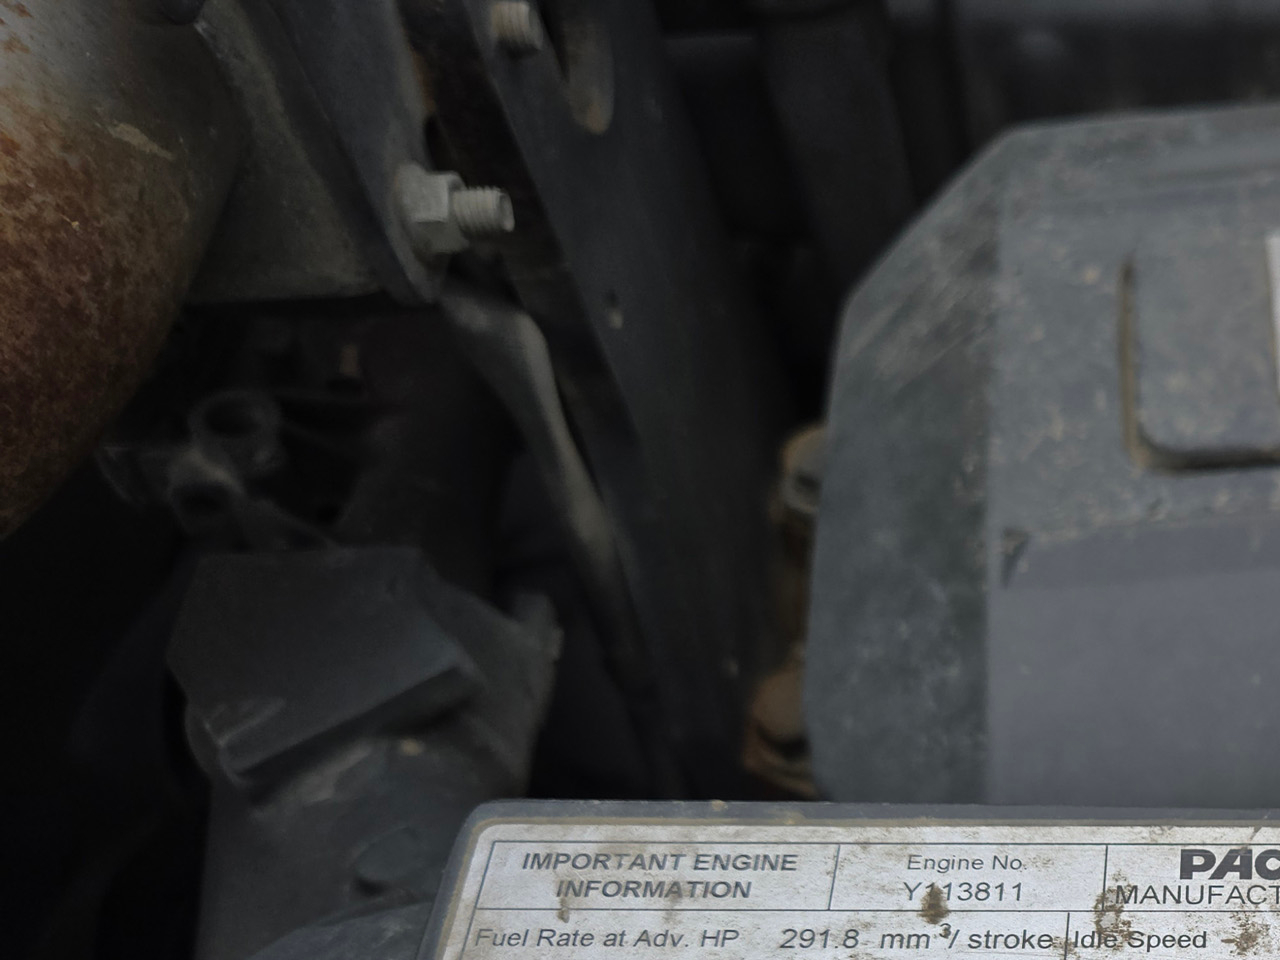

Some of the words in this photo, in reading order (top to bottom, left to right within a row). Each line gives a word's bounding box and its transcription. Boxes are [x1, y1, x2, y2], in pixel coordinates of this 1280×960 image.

[522, 853, 686, 871] IMPORTANT
[694, 853, 798, 871] ENGINE
[907, 854, 984, 873] Engine
[992, 855, 1027, 871] No.
[556, 879, 752, 899] INFORMATION
[475, 928, 528, 948] Fuel
[536, 928, 597, 948] Rate
[604, 930, 632, 948] at
[639, 928, 691, 948] Adv.
[700, 928, 740, 948] HP
[779, 928, 860, 949] 291.8
[967, 929, 1053, 950] stroke
[1073, 930, 1118, 949] Idle
[1127, 930, 1208, 952] Speed
